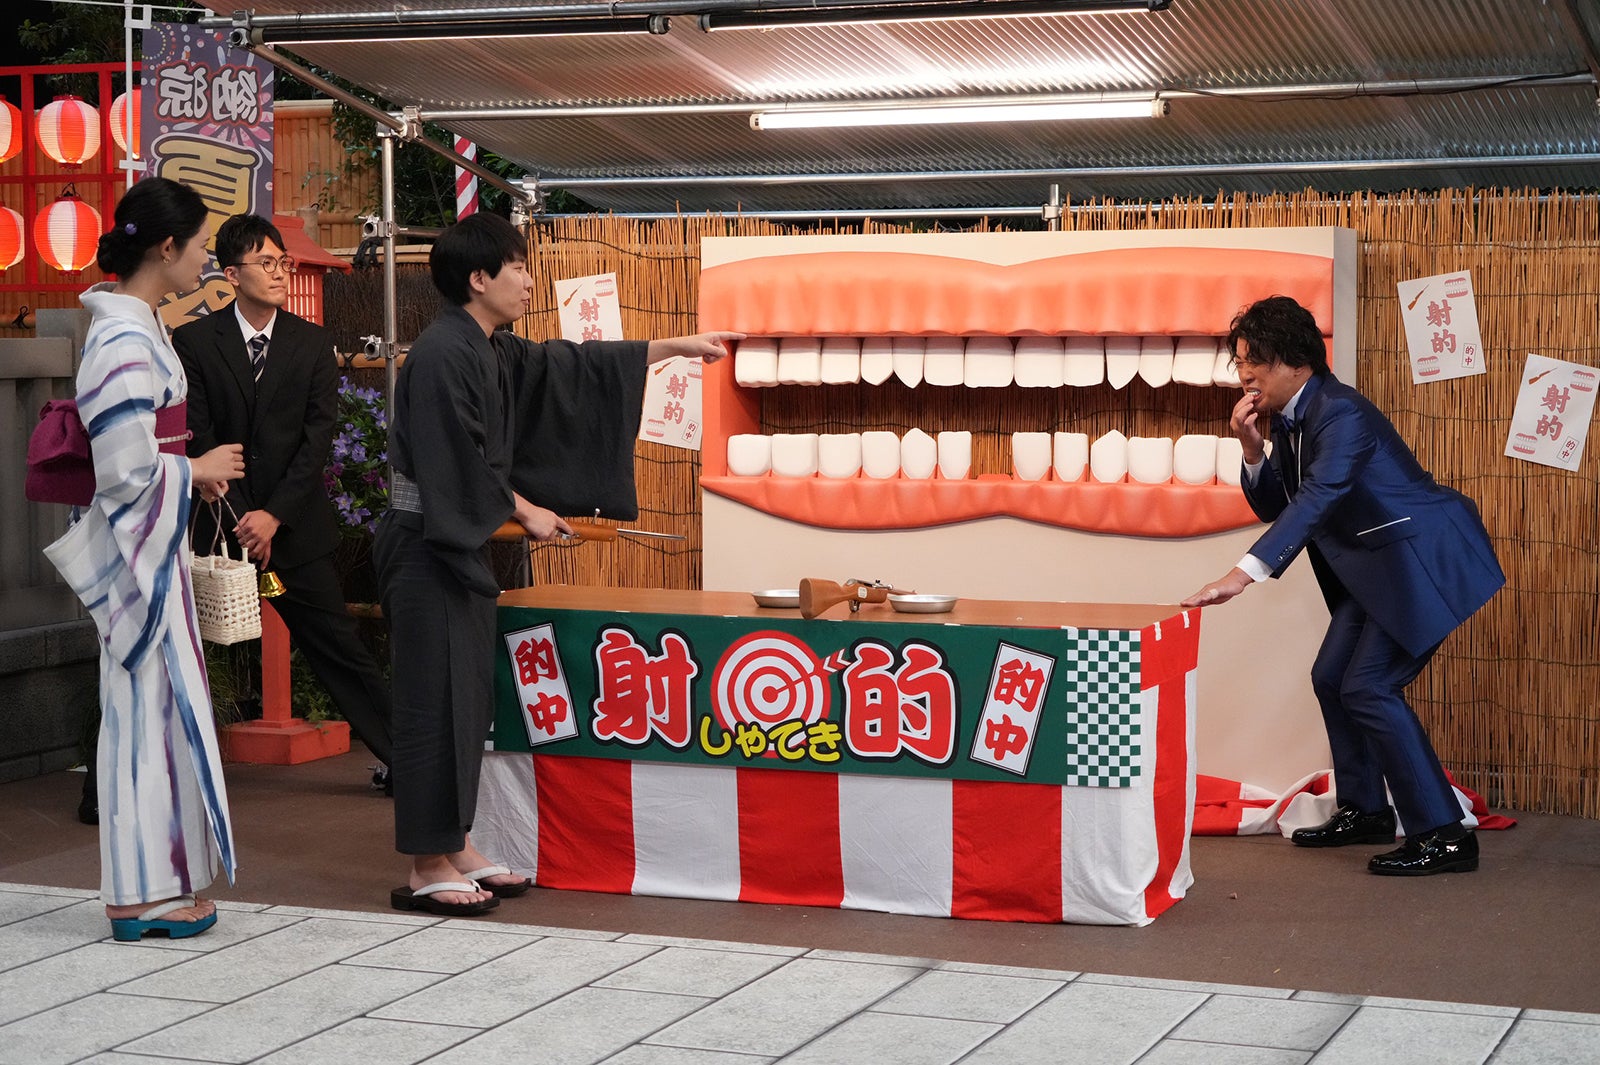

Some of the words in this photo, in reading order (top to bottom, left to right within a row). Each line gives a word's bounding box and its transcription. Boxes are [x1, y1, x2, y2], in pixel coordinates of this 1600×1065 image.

[1425, 299, 1457, 354] 射的
[1464, 345, 1475, 366] 的中
[663, 373, 689, 425] 射的
[1535, 383, 1571, 442] 射的
[685, 422, 697, 440] 的中
[1561, 439, 1576, 459] 的中
[513, 636, 568, 737] 的中
[985, 658, 1045, 761] 的中
